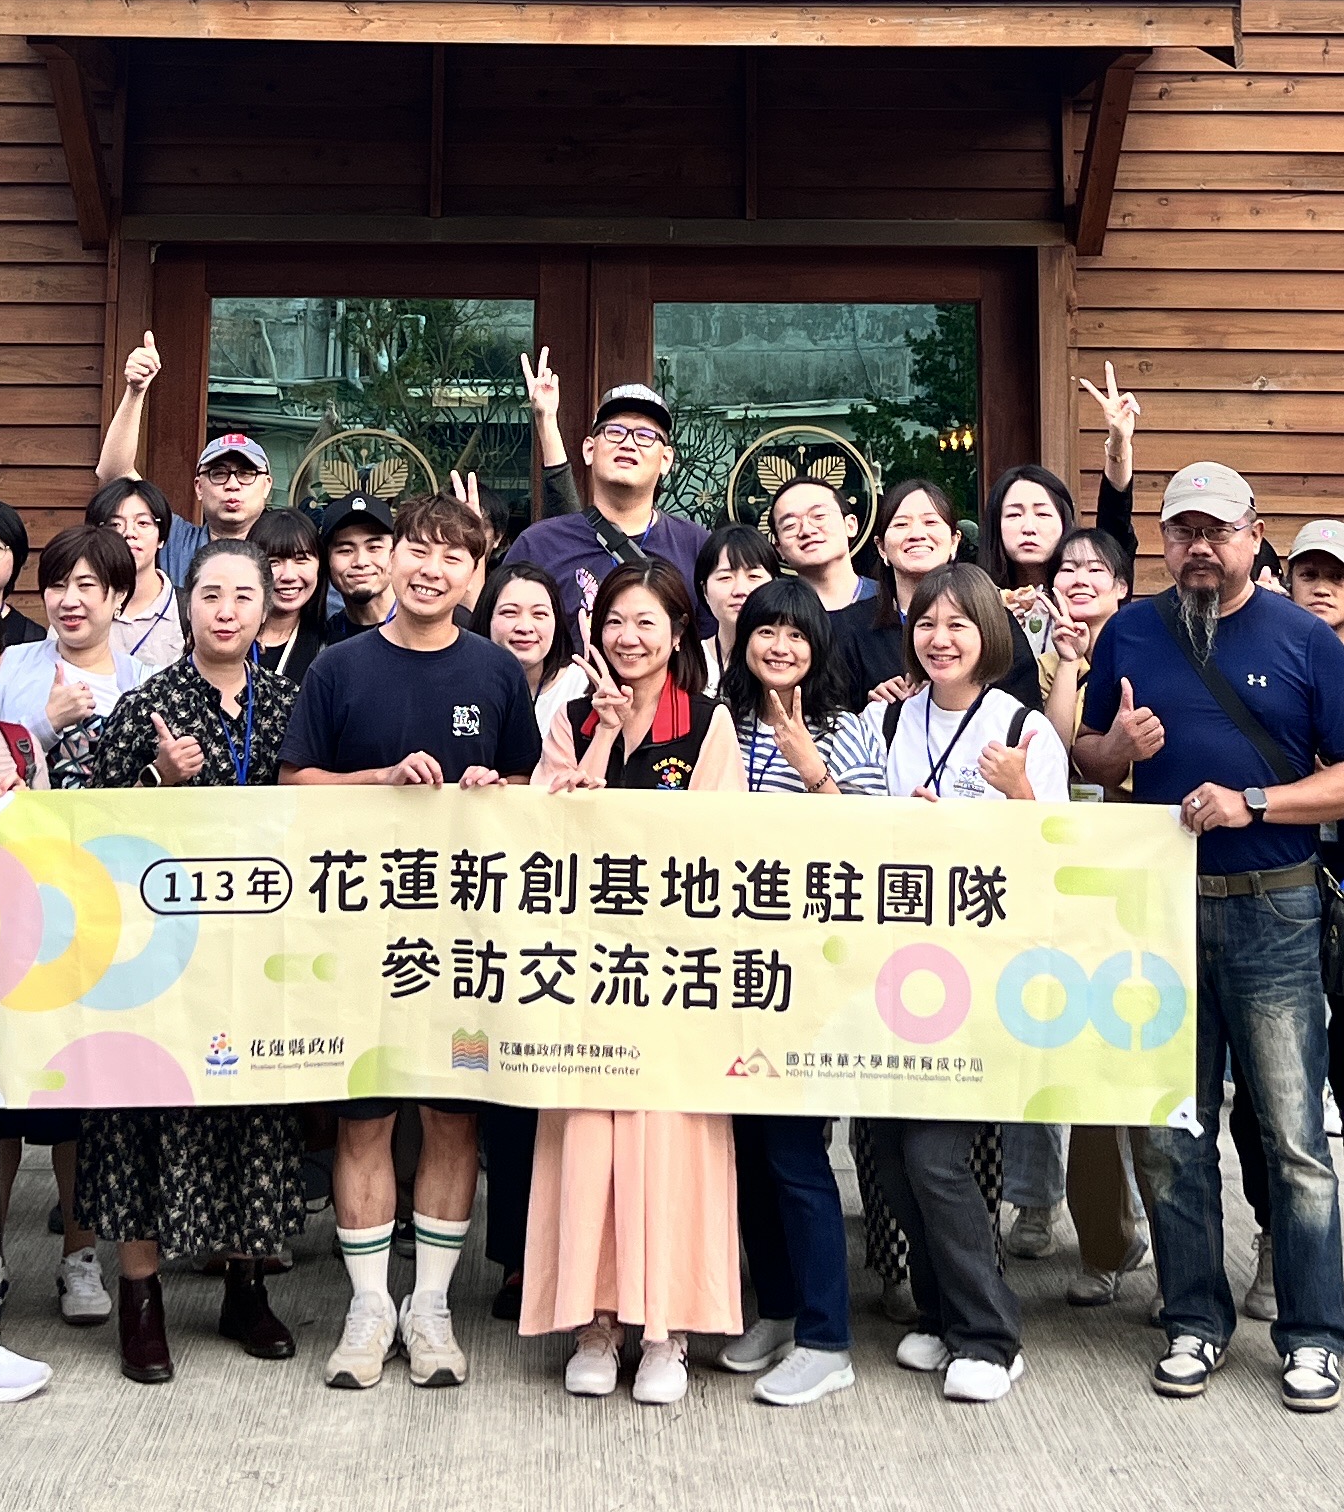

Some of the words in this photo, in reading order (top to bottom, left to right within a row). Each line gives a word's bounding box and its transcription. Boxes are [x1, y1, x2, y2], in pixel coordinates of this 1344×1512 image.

[162, 867, 283, 905] 113年
[308, 847, 1008, 928] 花蓮新創基地進駐團隊
[381, 936, 793, 1013] 參訪交流活動
[250, 1036, 346, 1057] 花蓮縣政府
[499, 1041, 641, 1059] 花蓮縣政府青年發展中心
[499, 1061, 529, 1073] Youth
[531, 1062, 601, 1075] Development
[604, 1064, 641, 1076] Center
[786, 1051, 984, 1073] 國立東華大學創新育成中心
[954, 1074, 984, 1083] Center
